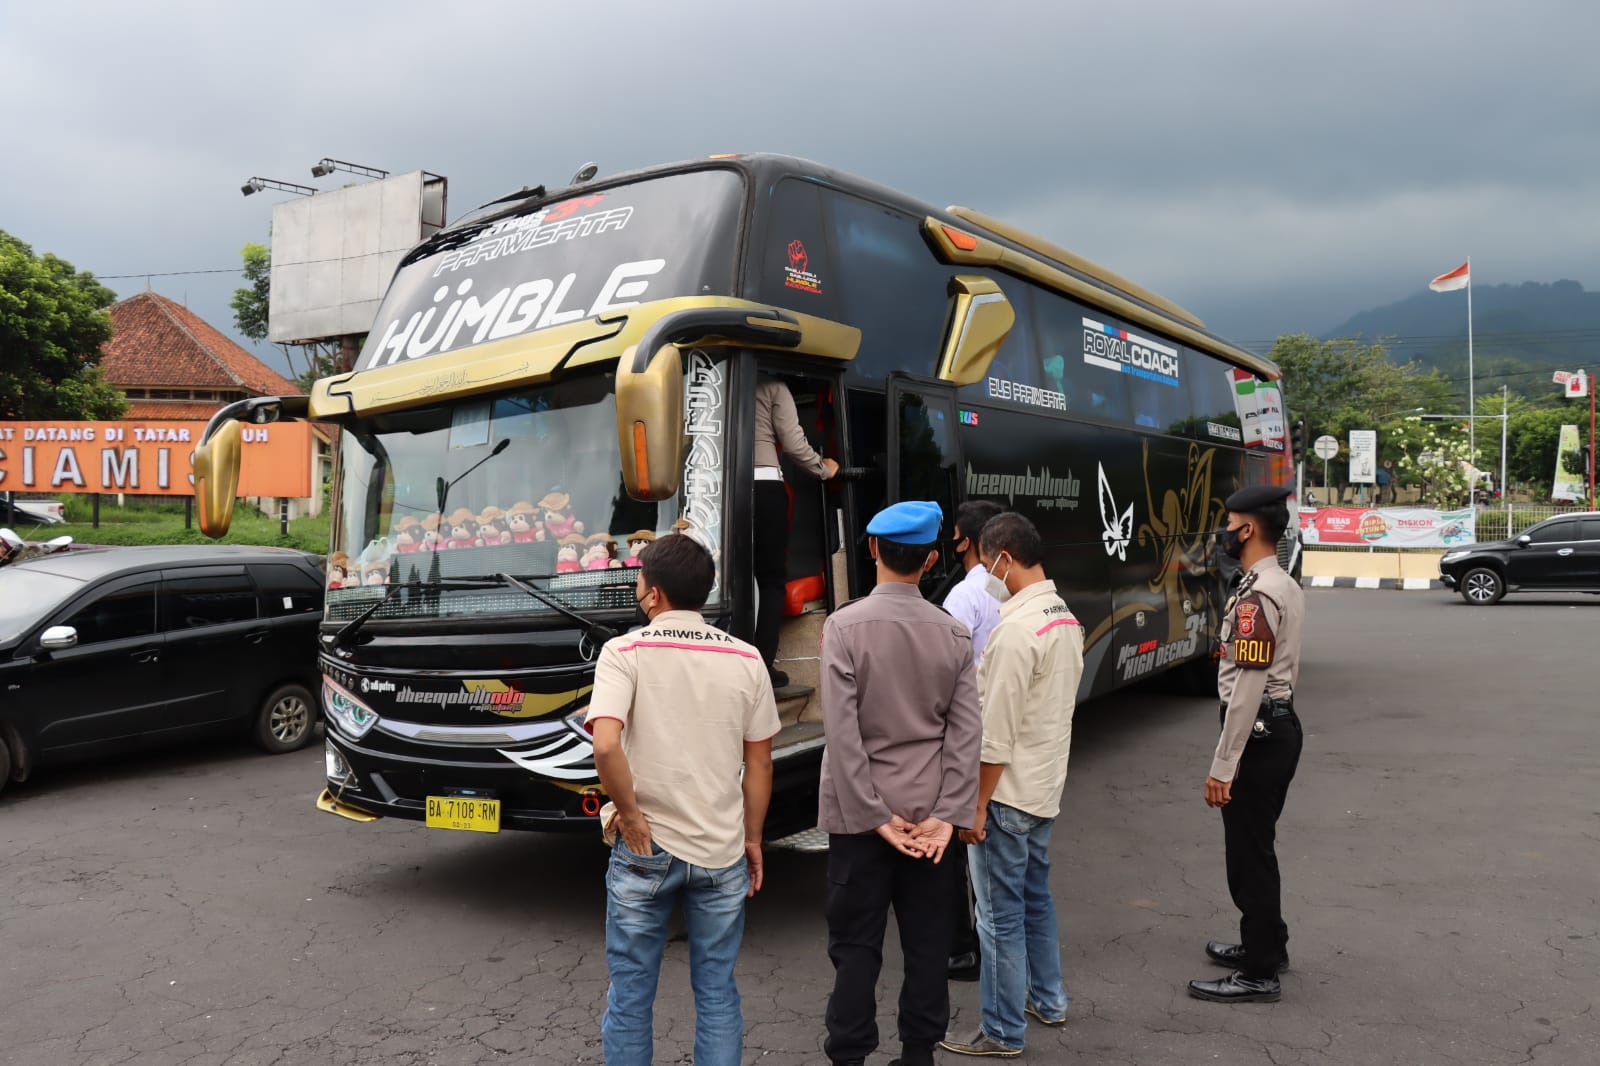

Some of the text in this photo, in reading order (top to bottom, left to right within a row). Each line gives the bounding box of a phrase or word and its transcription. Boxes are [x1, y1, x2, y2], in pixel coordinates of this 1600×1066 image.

[433, 206, 634, 278] PARIWISATA
[1083, 329, 1178, 377] ROYAL COACH
[988, 377, 1012, 400] BUS
[24, 428, 96, 442] DATANG
[105, 428, 124, 442] DI
[134, 428, 191, 442] TATAR
[0, 447, 196, 489] IAMI
[965, 460, 1080, 507] heemobillindo
[641, 629, 734, 643] PARIWISATA
[1123, 651, 1155, 681] HIGH
[429, 799, 496, 821] BA 7108 RM
